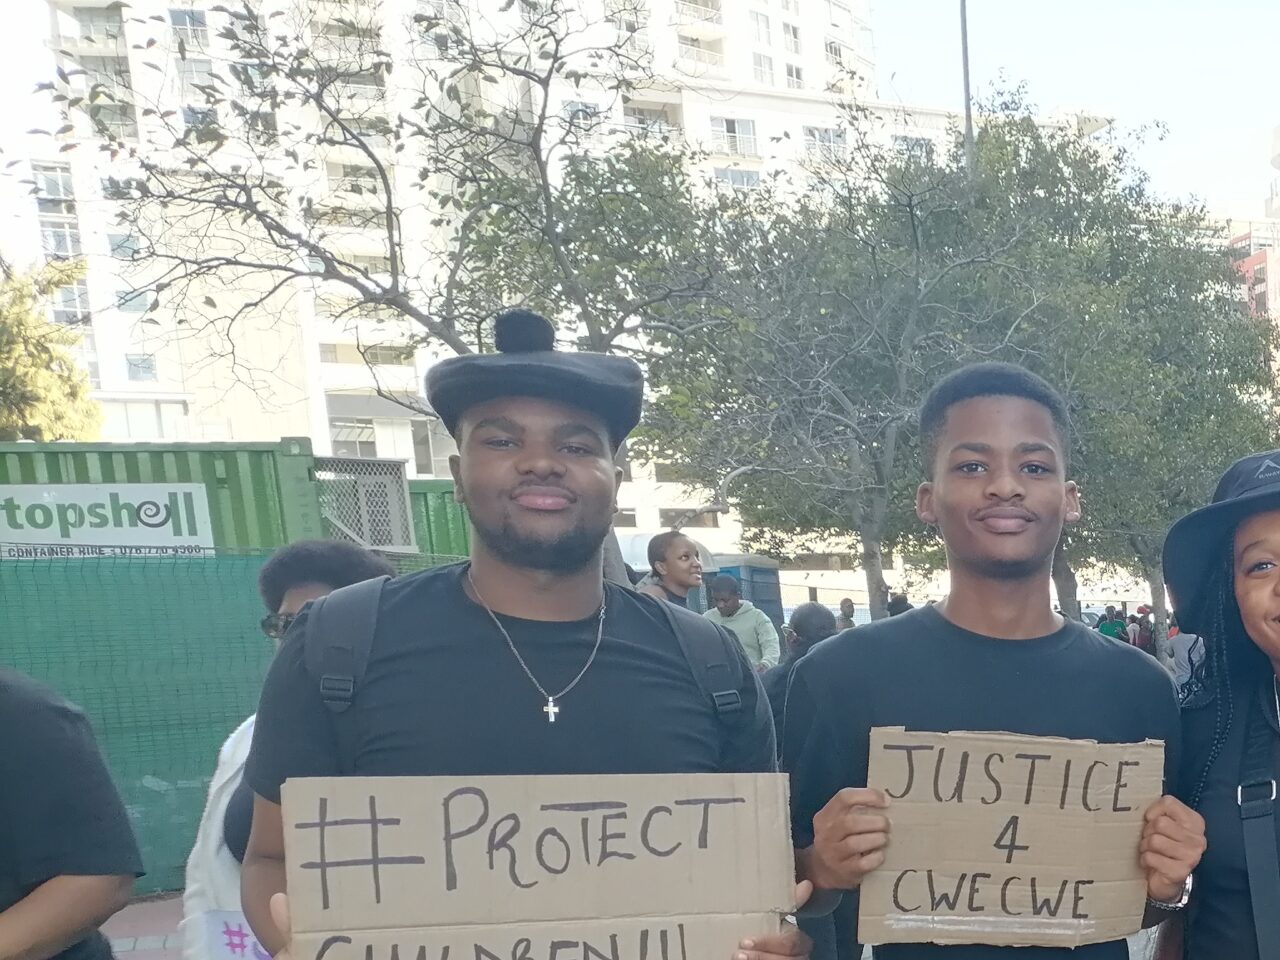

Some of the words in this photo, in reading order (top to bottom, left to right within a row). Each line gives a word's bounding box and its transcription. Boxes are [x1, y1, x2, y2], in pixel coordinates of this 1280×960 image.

[8, 546, 74, 558] CONTAINER
[79, 545, 106, 556] HIRE
[883, 744, 1140, 812] JUSTICE
[993, 815, 1029, 864] 4
[892, 869, 1095, 919] CWECWE
